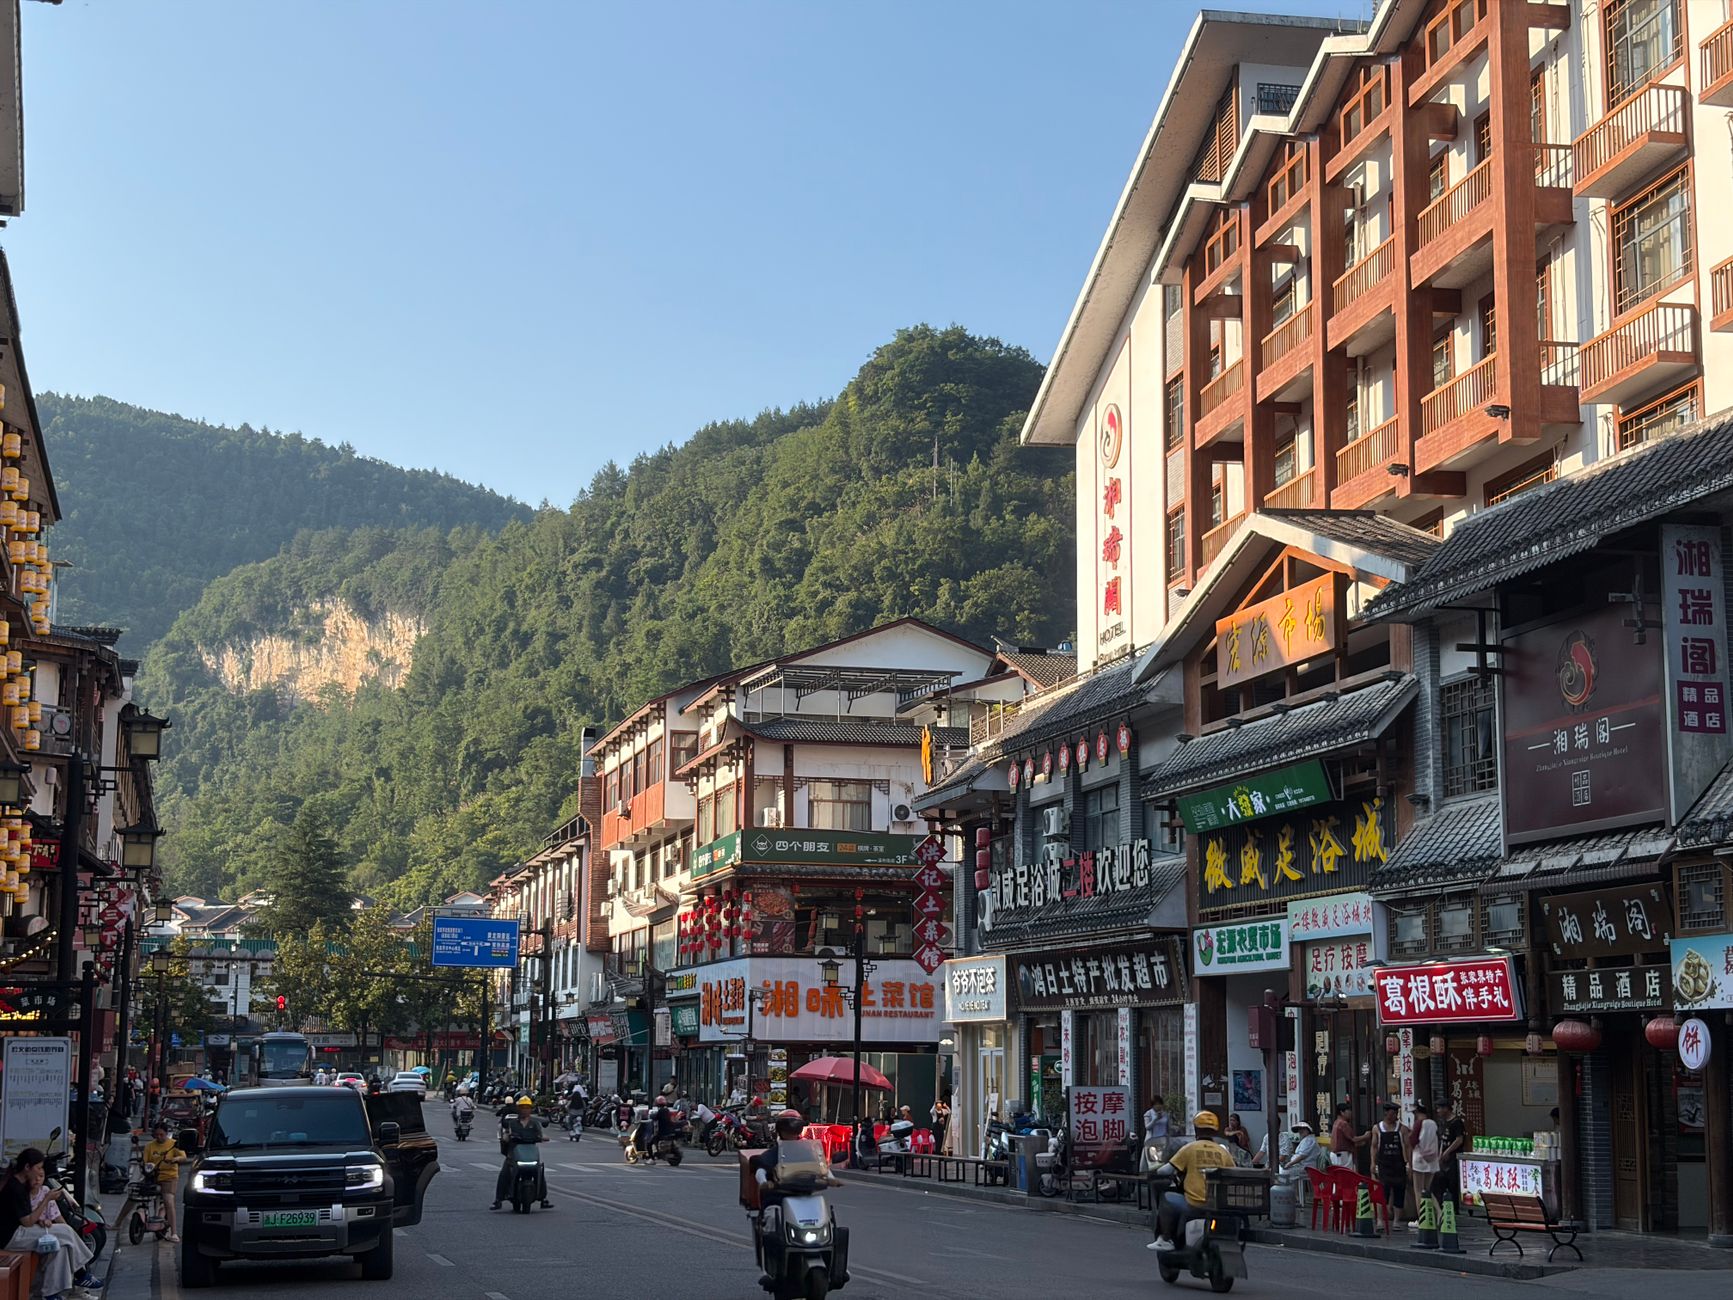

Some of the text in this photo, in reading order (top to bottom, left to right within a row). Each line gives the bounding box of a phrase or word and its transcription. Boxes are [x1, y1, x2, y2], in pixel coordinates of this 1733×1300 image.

[1676, 540, 1716, 674] 湘瑞阁
[1099, 621, 1126, 645] HOTEL
[1682, 687, 1719, 703] 精品
[1683, 711, 1721, 728] 酒店
[1553, 717, 1610, 755] 湘瑞阁
[775, 840, 830, 852] 四个朋友
[895, 855, 908, 864] 3F
[1559, 899, 1652, 946] 湘瑞阁
[1311, 942, 1367, 973] 足疗按摩
[952, 966, 995, 995] 爷爷不泡茶
[1460, 968, 1504, 984] 张家界特产
[1561, 970, 1660, 1000] 精品酒店
[1380, 971, 1462, 1016] 葛根酥
[1462, 986, 1509, 1010] 伴手礼
[1621, 999, 1646, 1009] Boutique
[1646, 998, 1662, 1007] Hotel
[1074, 1092, 1125, 1115] 按摩
[1075, 1118, 1125, 1142] 泡脚
